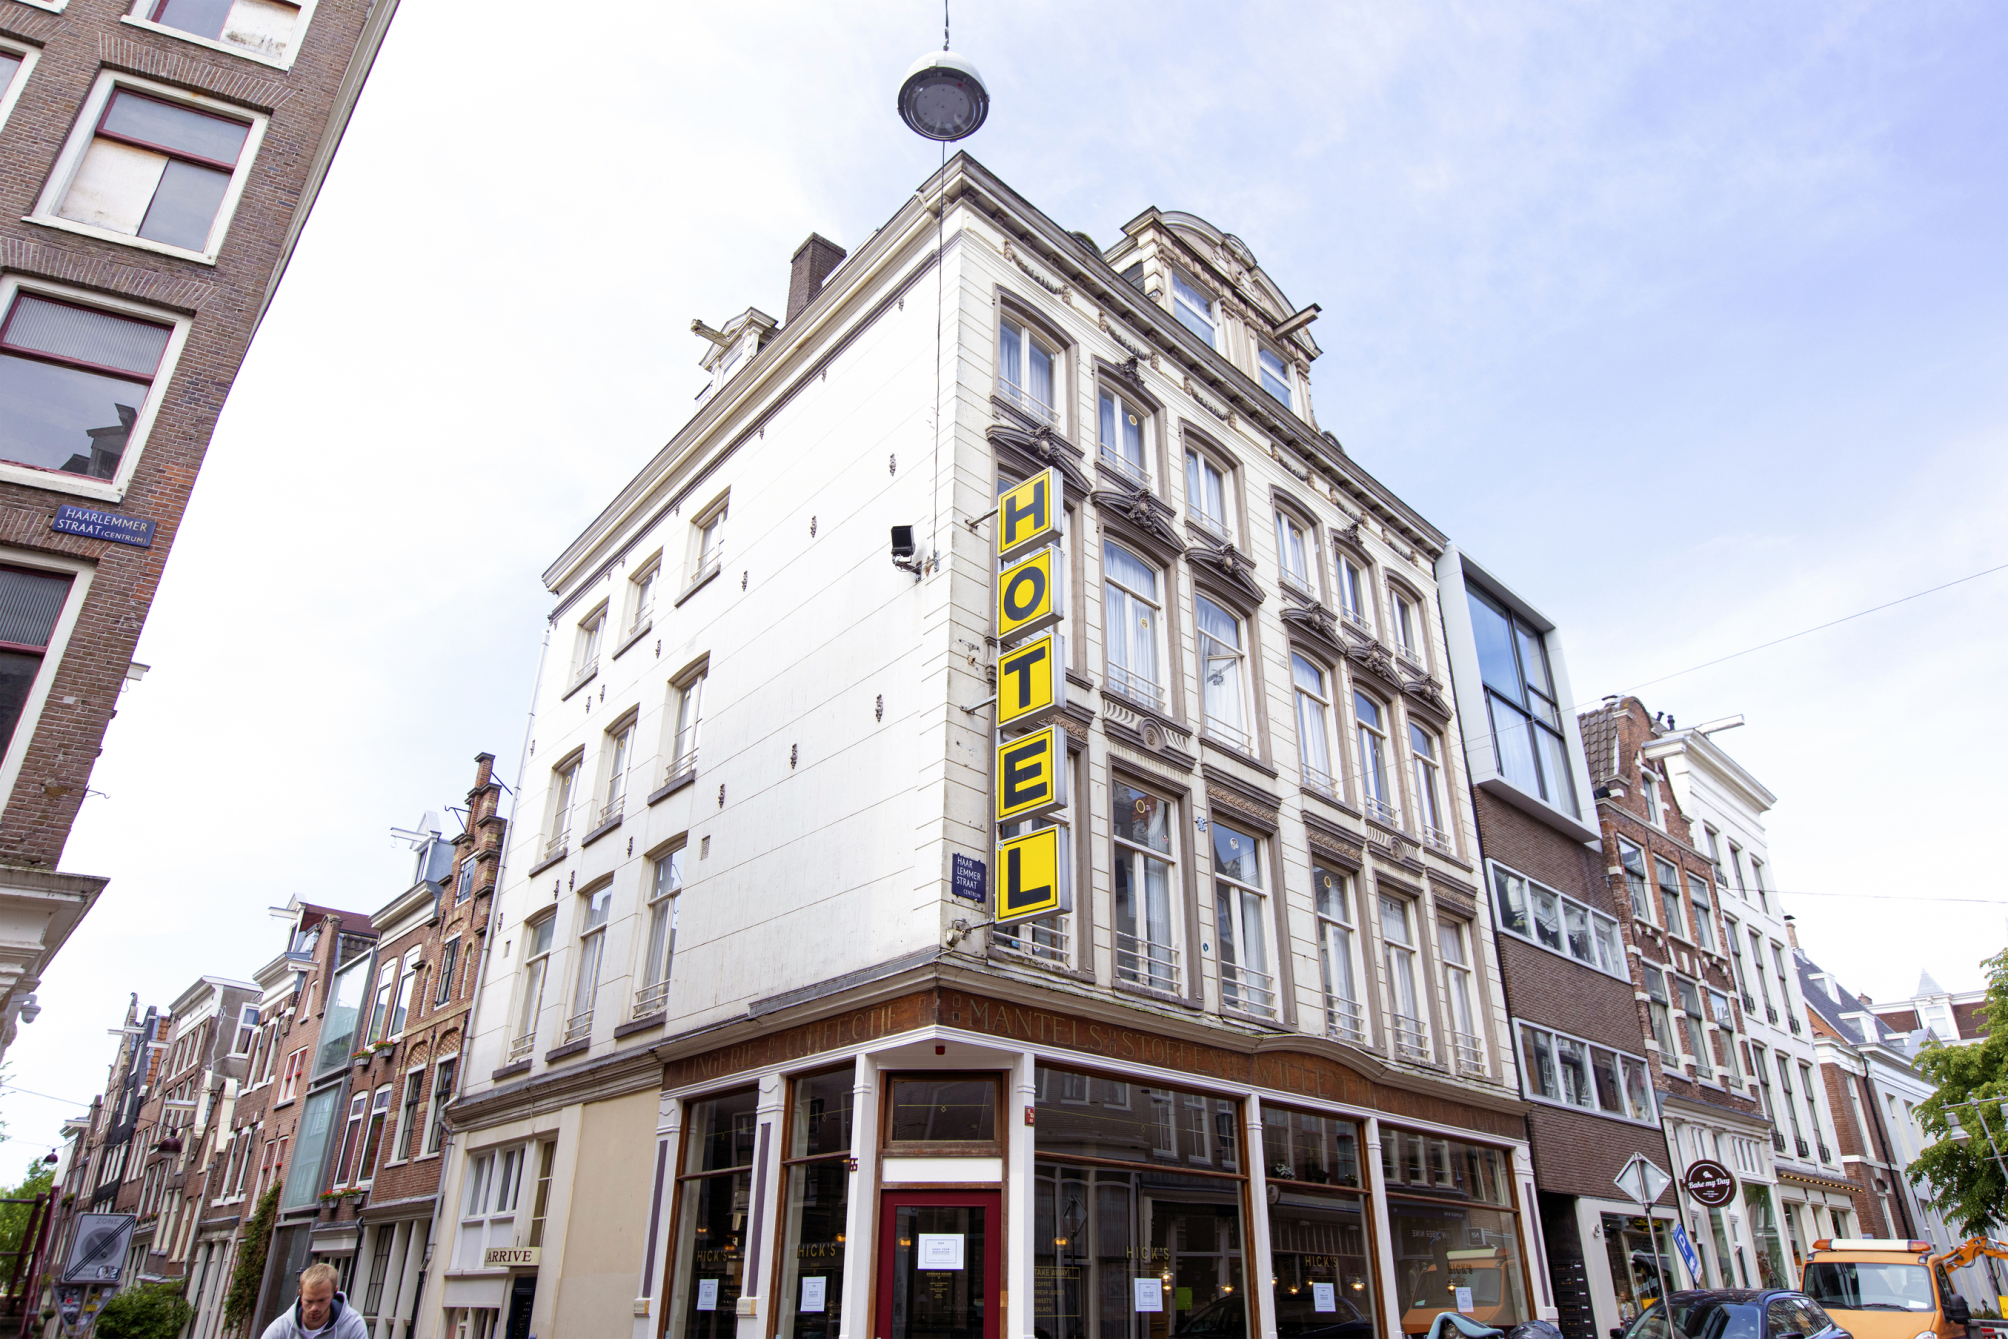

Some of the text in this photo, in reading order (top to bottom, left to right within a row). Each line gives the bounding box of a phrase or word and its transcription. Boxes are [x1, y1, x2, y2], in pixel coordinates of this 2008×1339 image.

[57, 519, 101, 535] STRAAT
[65, 508, 147, 532] HAARLEMMER
[1003, 479, 1051, 910] HOTEL
[957, 856, 973, 868] HAAR
[956, 866, 981, 881] LEMMER
[956, 876, 978, 890] STRAAT
[963, 888, 982, 899] CENTRUM
[682, 1003, 902, 1084] LINGERIE CONFECTIE
[969, 998, 1104, 1051] MANTELS
[1121, 1030, 1223, 1076] STOFFEN
[1252, 1053, 1348, 1102] WILLEM
[1688, 1177, 1731, 1189] Bake my Day
[95, 1217, 120, 1225] ZONE
[696, 1250, 728, 1262] HICK'S
[797, 1243, 836, 1258] HICK'S
[1126, 1246, 1170, 1260] HICK'S
[1304, 1255, 1338, 1268] HICK'S
[1447, 1262, 1474, 1275] HICK'S
[1034, 1268, 1068, 1277] TAKE AWAY
